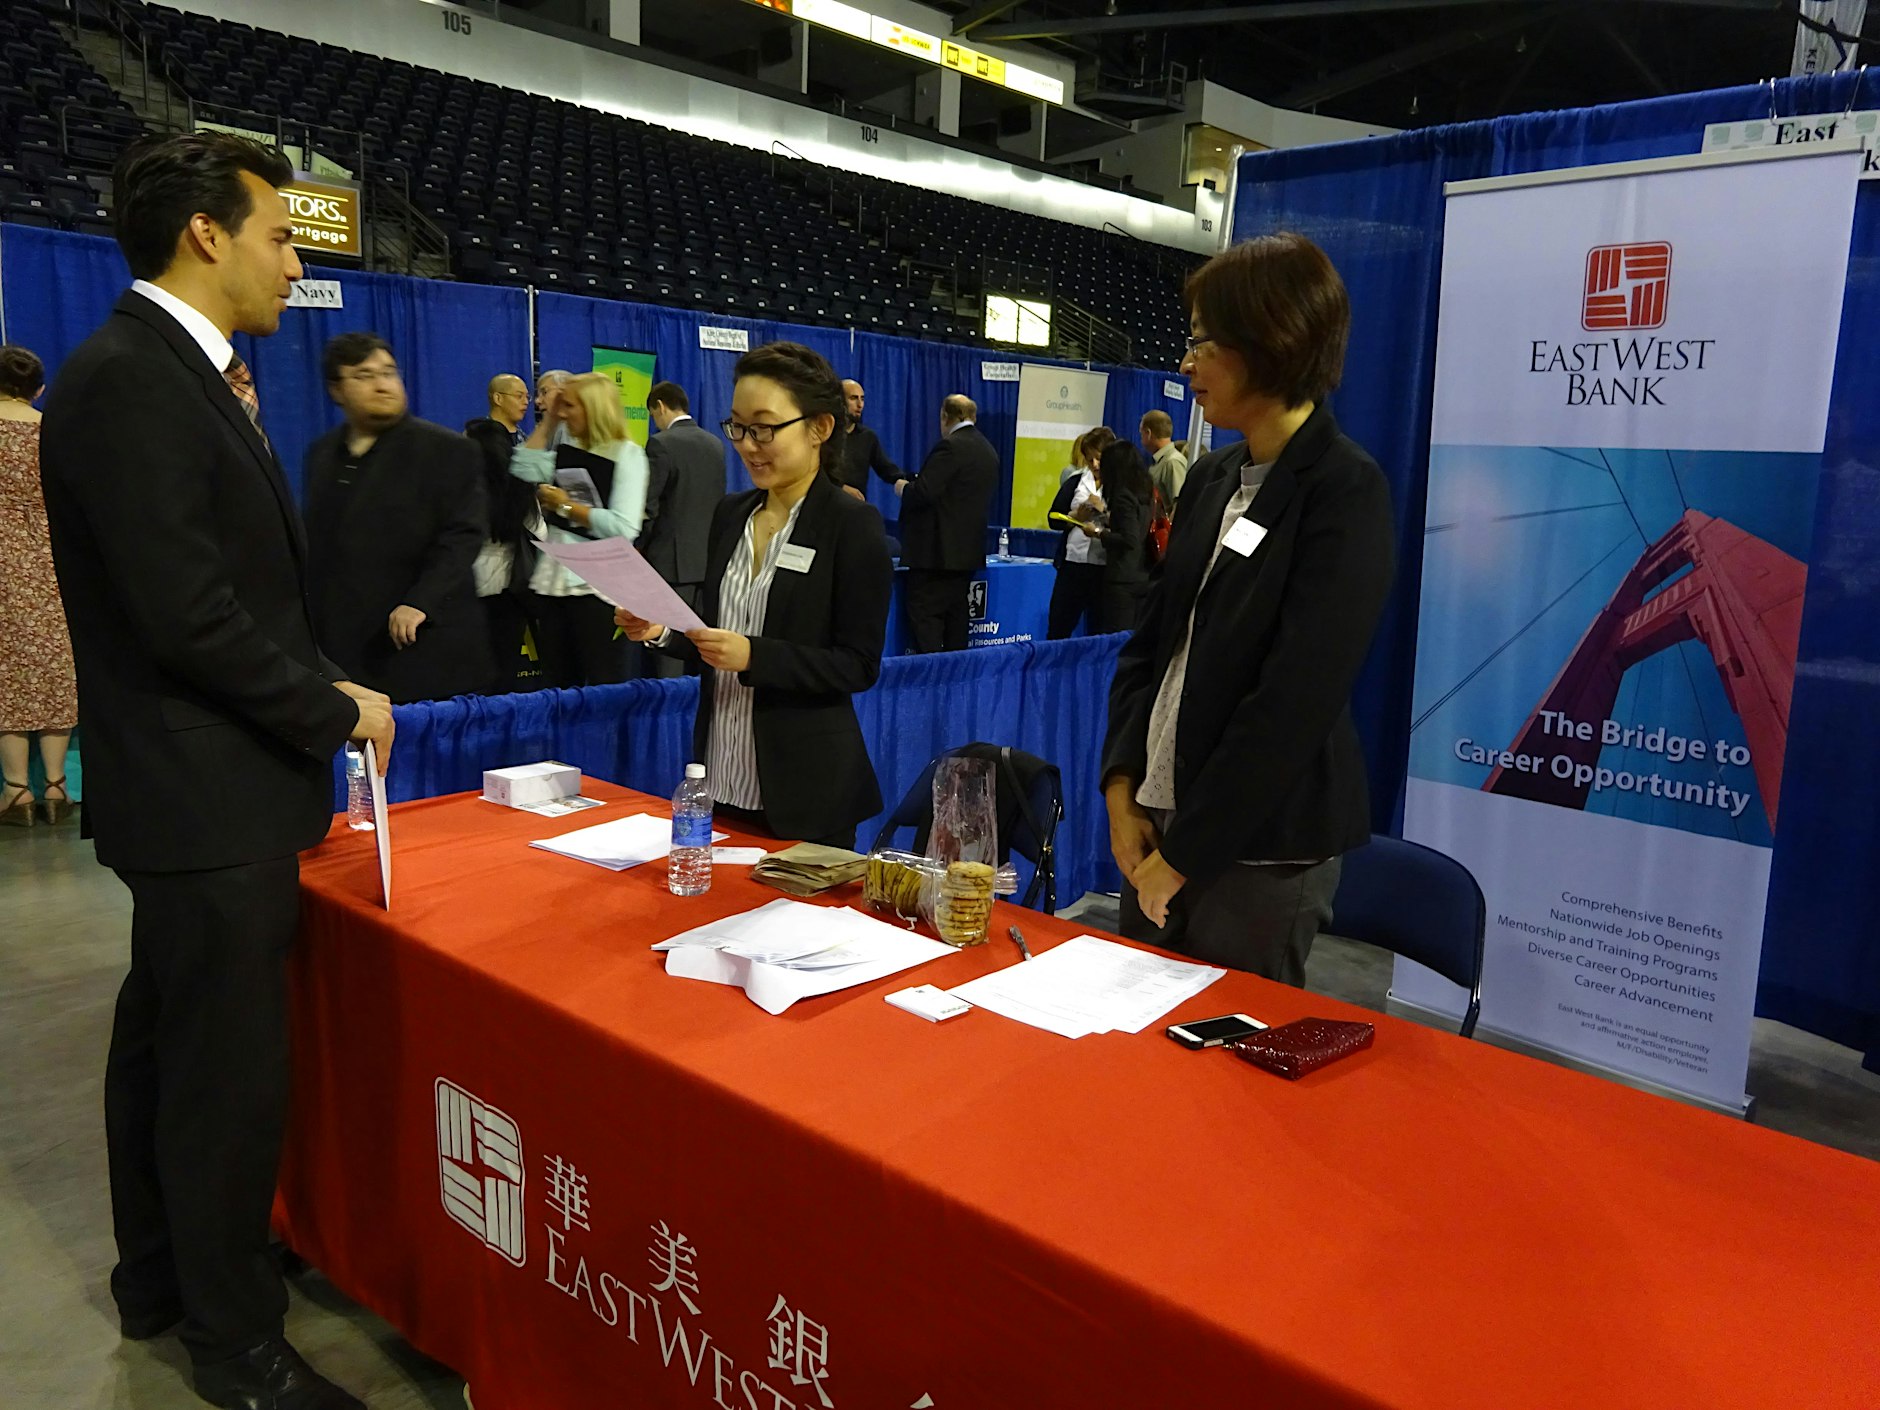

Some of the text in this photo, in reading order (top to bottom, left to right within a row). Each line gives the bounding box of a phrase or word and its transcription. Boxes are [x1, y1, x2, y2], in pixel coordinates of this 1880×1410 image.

[442, 10, 471, 36] 105
[860, 125, 878, 144] 104
[1775, 120, 1839, 145] East
[278, 191, 347, 223] TORS.
[291, 225, 348, 245] ortgage
[1202, 218, 1212, 232] 103
[296, 284, 336, 303] Navy
[1046, 400, 1081, 411] GroupHealth
[1566, 373, 1667, 406] BANK
[1005, 635, 1016, 644] and
[1016, 633, 1032, 643] Parks
[1539, 709, 1750, 766] The Bridge to
[1454, 737, 1751, 817] Career Opportunity
[1561, 891, 1723, 940] Comprehensive Benefits
[1497, 914, 1719, 981] Mentorship and Training Programs
[1550, 908, 1721, 962] Nationwide Job Openings
[1528, 942, 1716, 1002] Diverse Career Opportunities
[1574, 975, 1714, 1023] Career Advancement
[1558, 1003, 1573, 1013] East
[1575, 1008, 1593, 1019] West
[1595, 1014, 1613, 1025] Bank
[1635, 1026, 1658, 1038] equal
[1660, 1034, 1711, 1054] opportunity
[1581, 1021, 1596, 1030] and
[1597, 1026, 1639, 1043] affirmative
[1641, 1039, 1666, 1051] action
